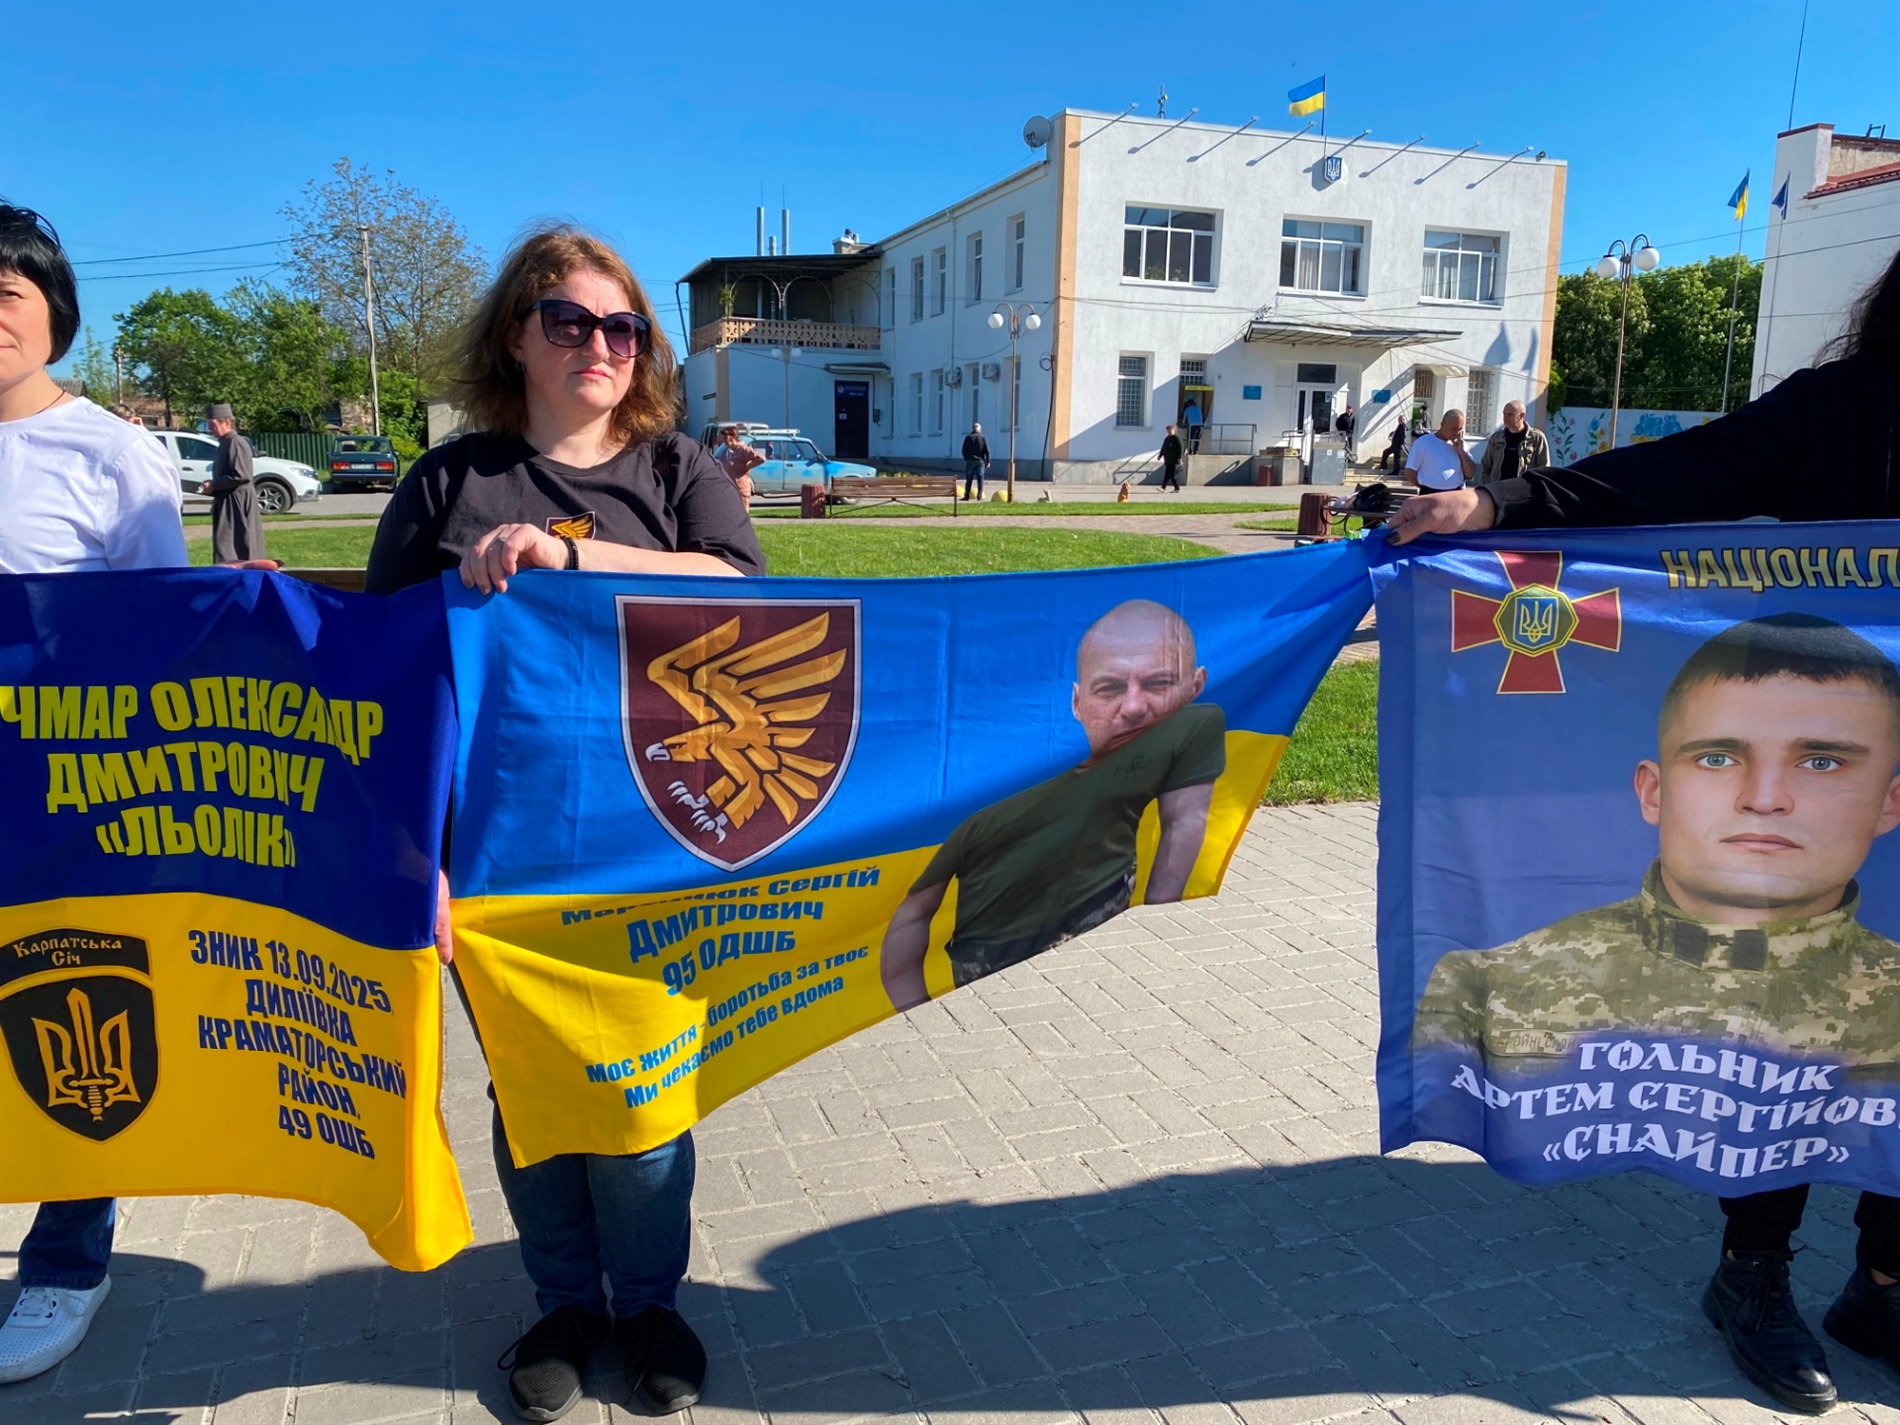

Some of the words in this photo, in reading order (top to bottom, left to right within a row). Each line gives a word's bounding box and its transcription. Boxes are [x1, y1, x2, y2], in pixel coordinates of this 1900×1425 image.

[1660, 547, 1900, 594] НАЦІОНАЛ
[46, 741, 325, 813] ДМИТРОВИЧ
[767, 865, 880, 895] Сергій
[13, 938, 122, 958] Карпатська
[51, 951, 80, 966] Січ
[188, 929, 264, 971] ЗНИК
[626, 901, 824, 964] Дмитрович
[662, 951, 696, 997] 95
[701, 930, 796, 971] ОДШБ
[245, 978, 358, 1047] ДИЛІЇВКА
[585, 1058, 635, 1083] Моє
[639, 1023, 697, 1072] життя
[707, 970, 792, 1028] боротьба
[797, 960, 819, 980] за
[824, 946, 869, 970] твоє
[624, 1082, 658, 1109] Ми
[661, 1030, 734, 1089] чекаємо
[736, 1002, 778, 1040] тебе
[781, 975, 844, 1016] вдома
[198, 1014, 407, 1099] КРАМАТОРСЬКИЙ
[1579, 1039, 1840, 1094] ГОЛЬНИК
[278, 1062, 361, 1121] РАЙОН.
[1451, 1064, 1615, 1119] АРТЕМ
[1628, 1082, 1900, 1133] СЕРГІЙОВ
[278, 1104, 312, 1140] 49
[316, 1112, 375, 1160] ОШБ
[1543, 1123, 1850, 1178] «СНАЙПЕР»
